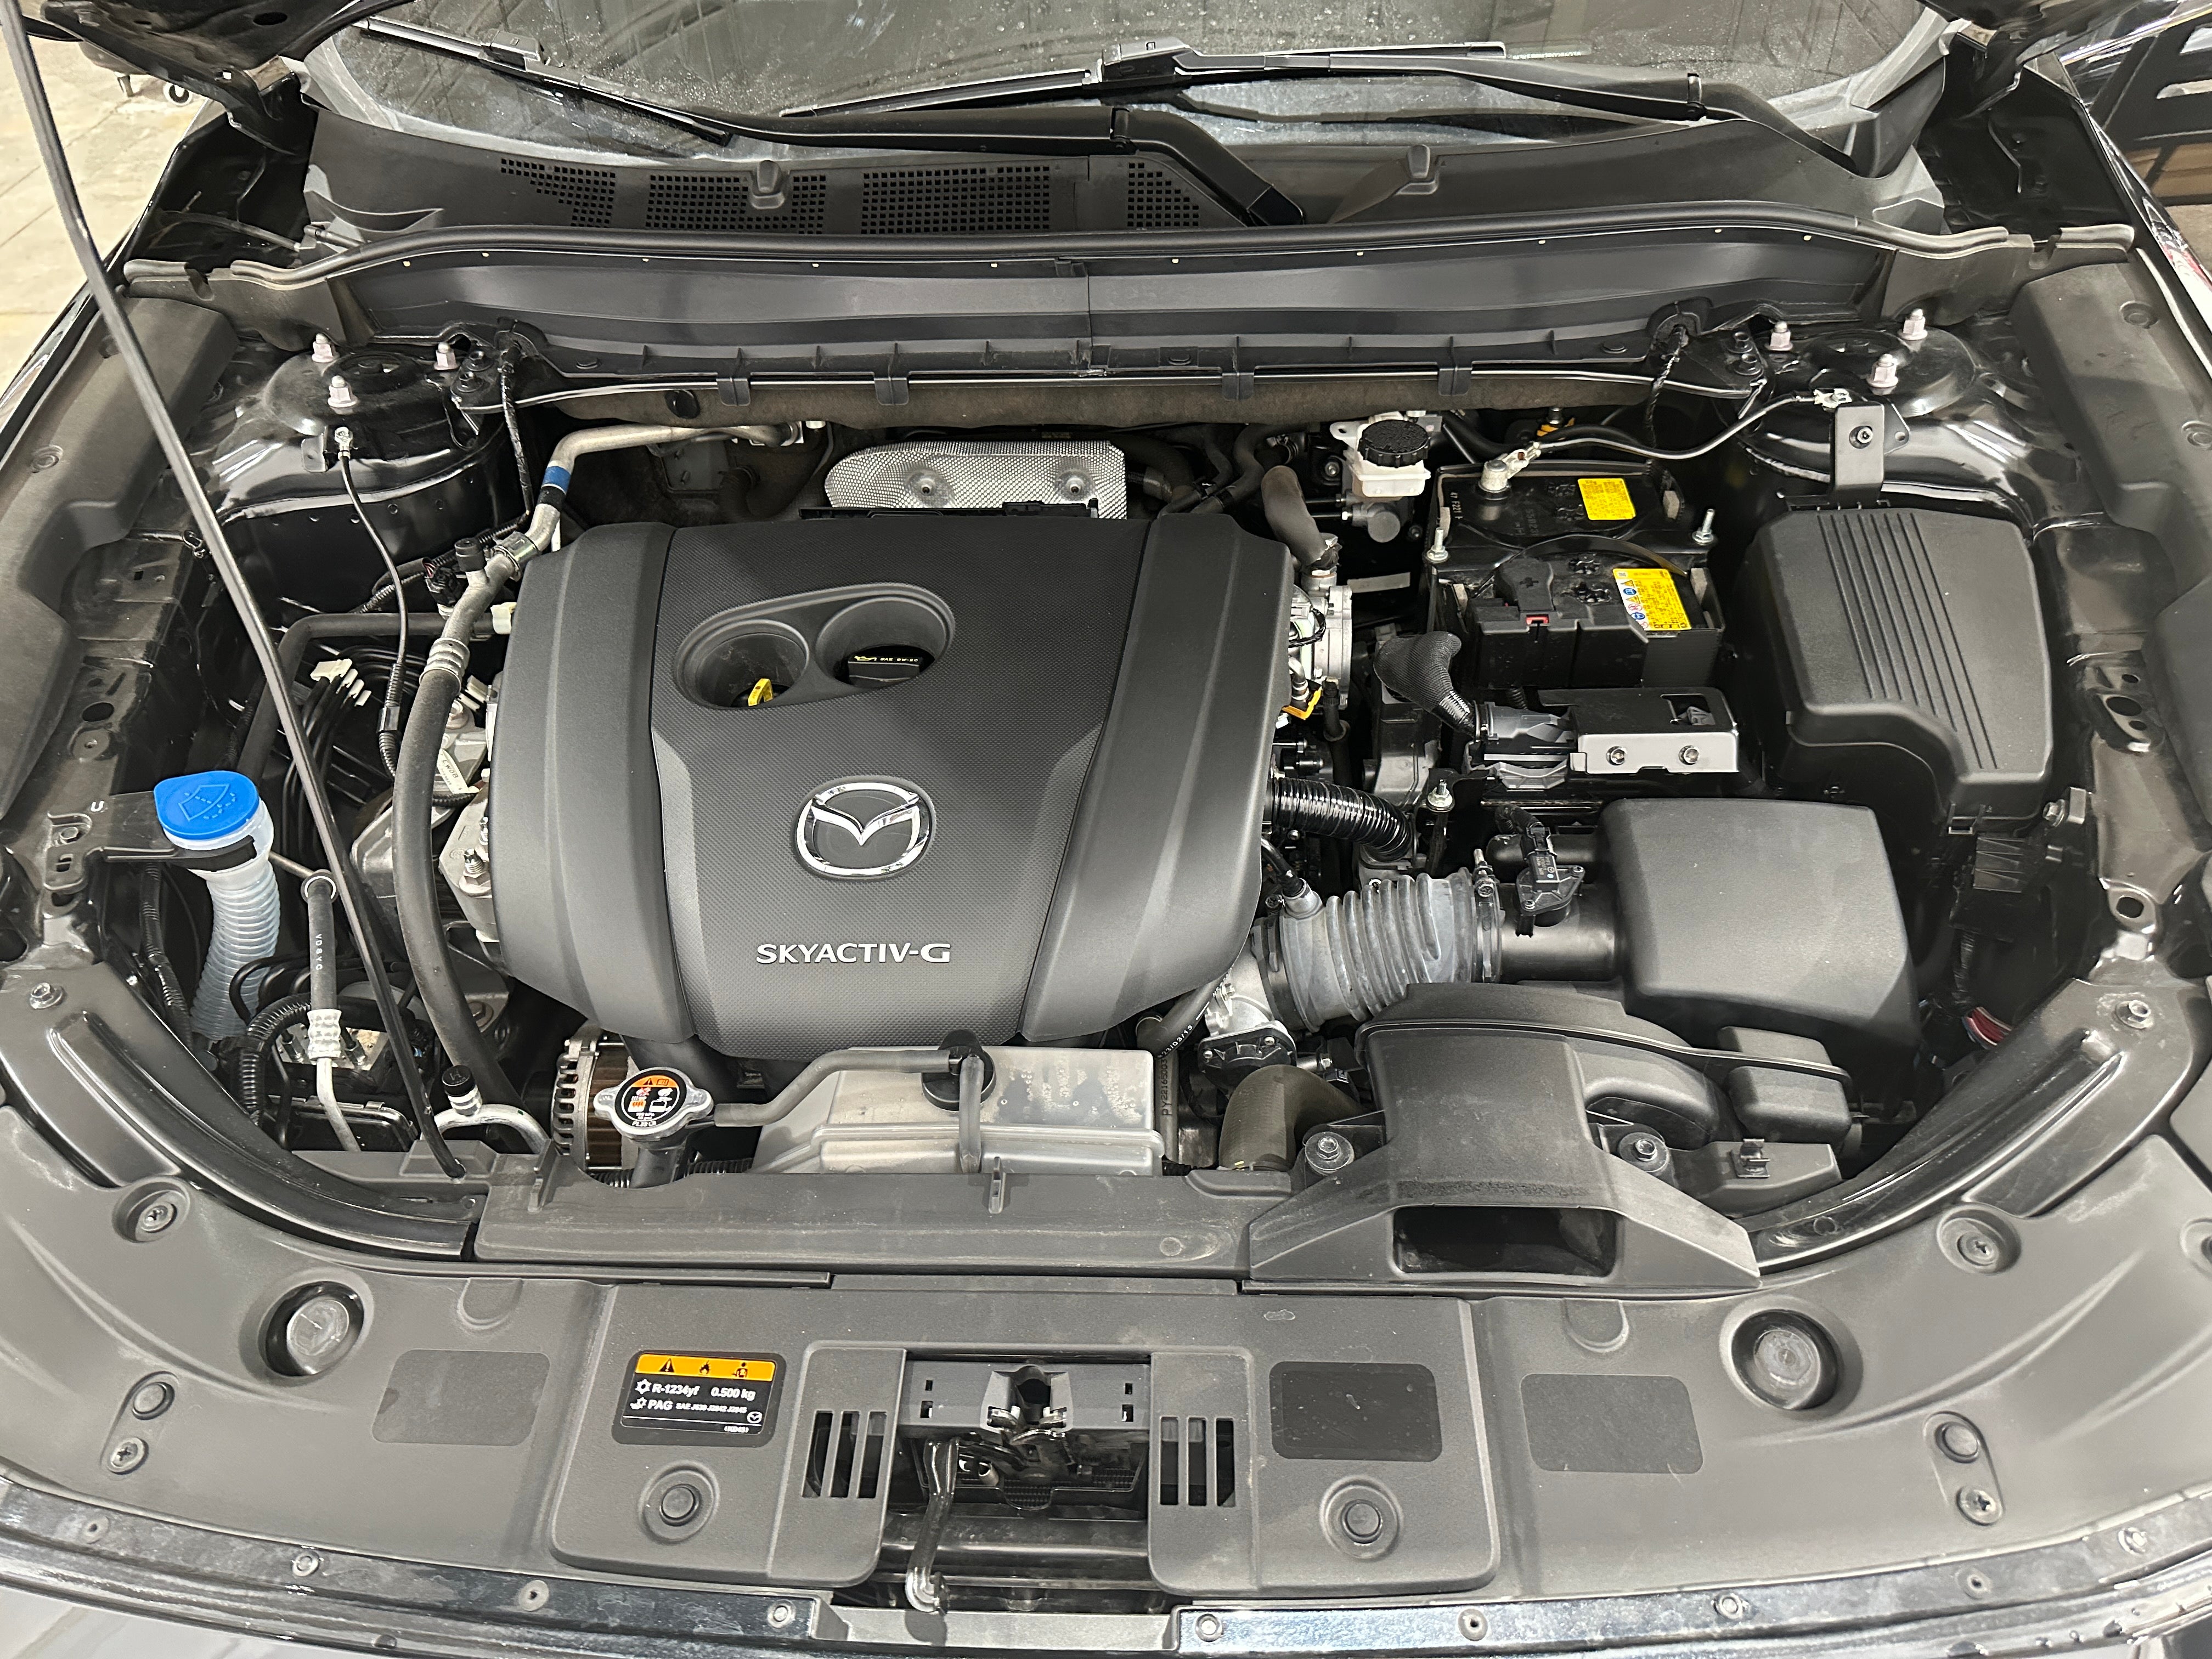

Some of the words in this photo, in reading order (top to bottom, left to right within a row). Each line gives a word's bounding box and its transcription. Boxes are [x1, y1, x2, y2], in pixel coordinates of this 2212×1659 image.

[757, 943, 951, 964] SKYACTIV-G
[651, 1383, 700, 1397] R-1234yf
[711, 1386, 741, 1398] 0.500
[741, 1389, 756, 1401] kg
[647, 1400, 673, 1410] PAG
